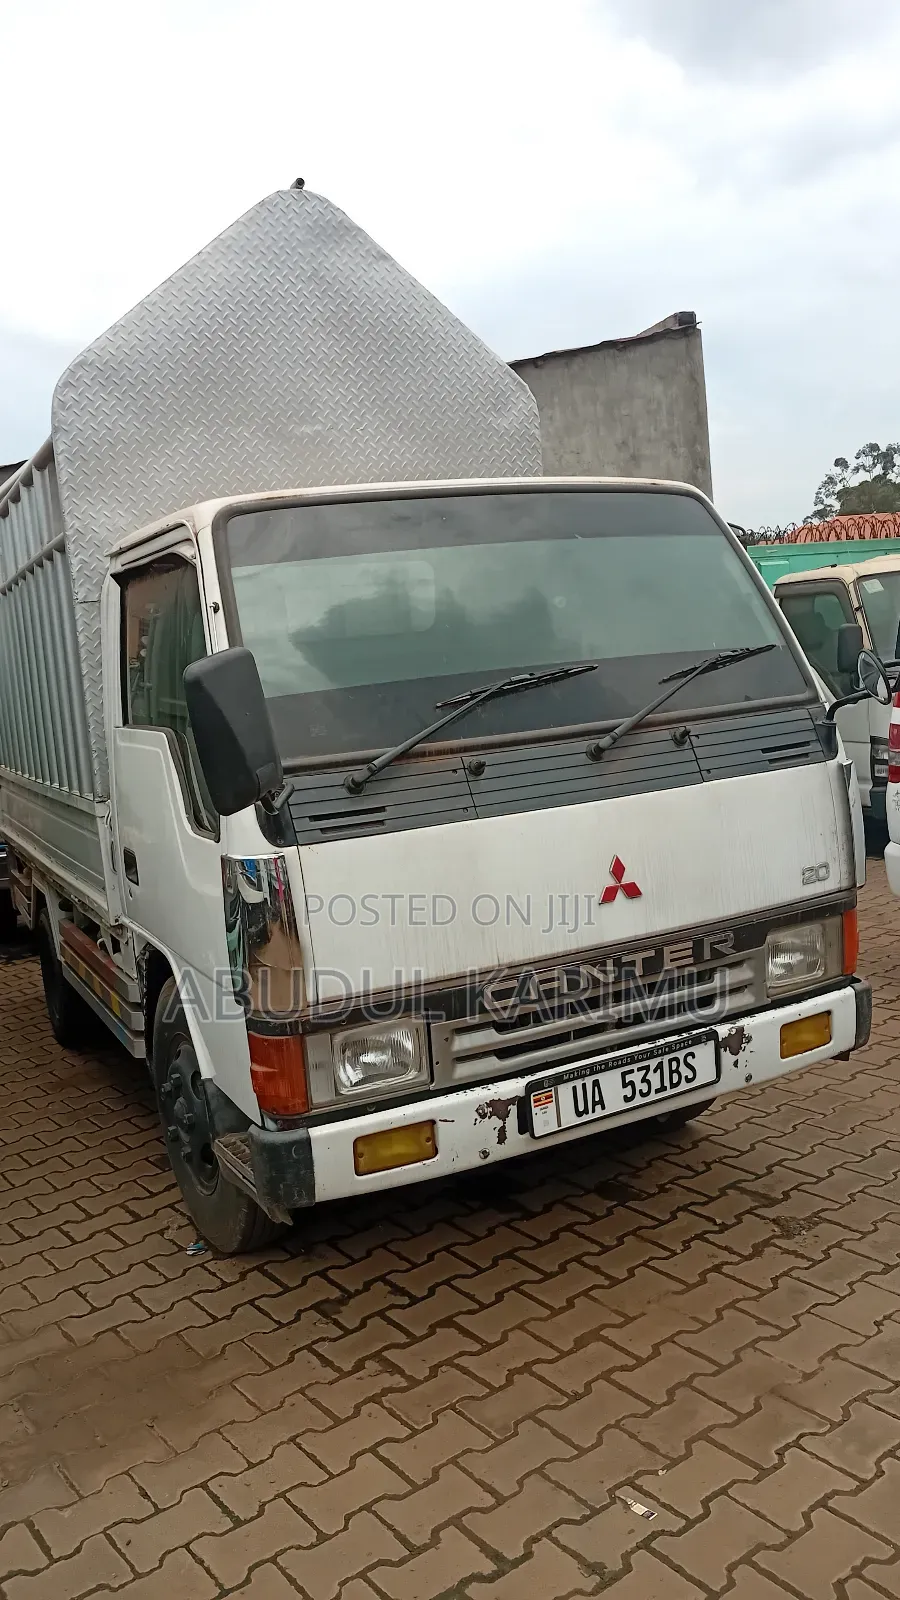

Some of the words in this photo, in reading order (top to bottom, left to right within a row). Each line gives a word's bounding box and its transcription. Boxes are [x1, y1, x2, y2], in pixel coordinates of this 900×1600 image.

[802, 862, 830, 885] 20
[483, 930, 737, 1013] CANTER
[563, 1068, 590, 1080] Making
[593, 1064, 605, 1072] the
[608, 1056, 631, 1068] Roads
[634, 1052, 651, 1060] Your
[653, 1046, 669, 1056] Safe
[671, 1040, 692, 1050] Space
[572, 1078, 606, 1118] UA
[620, 1052, 697, 1104] 531BS
